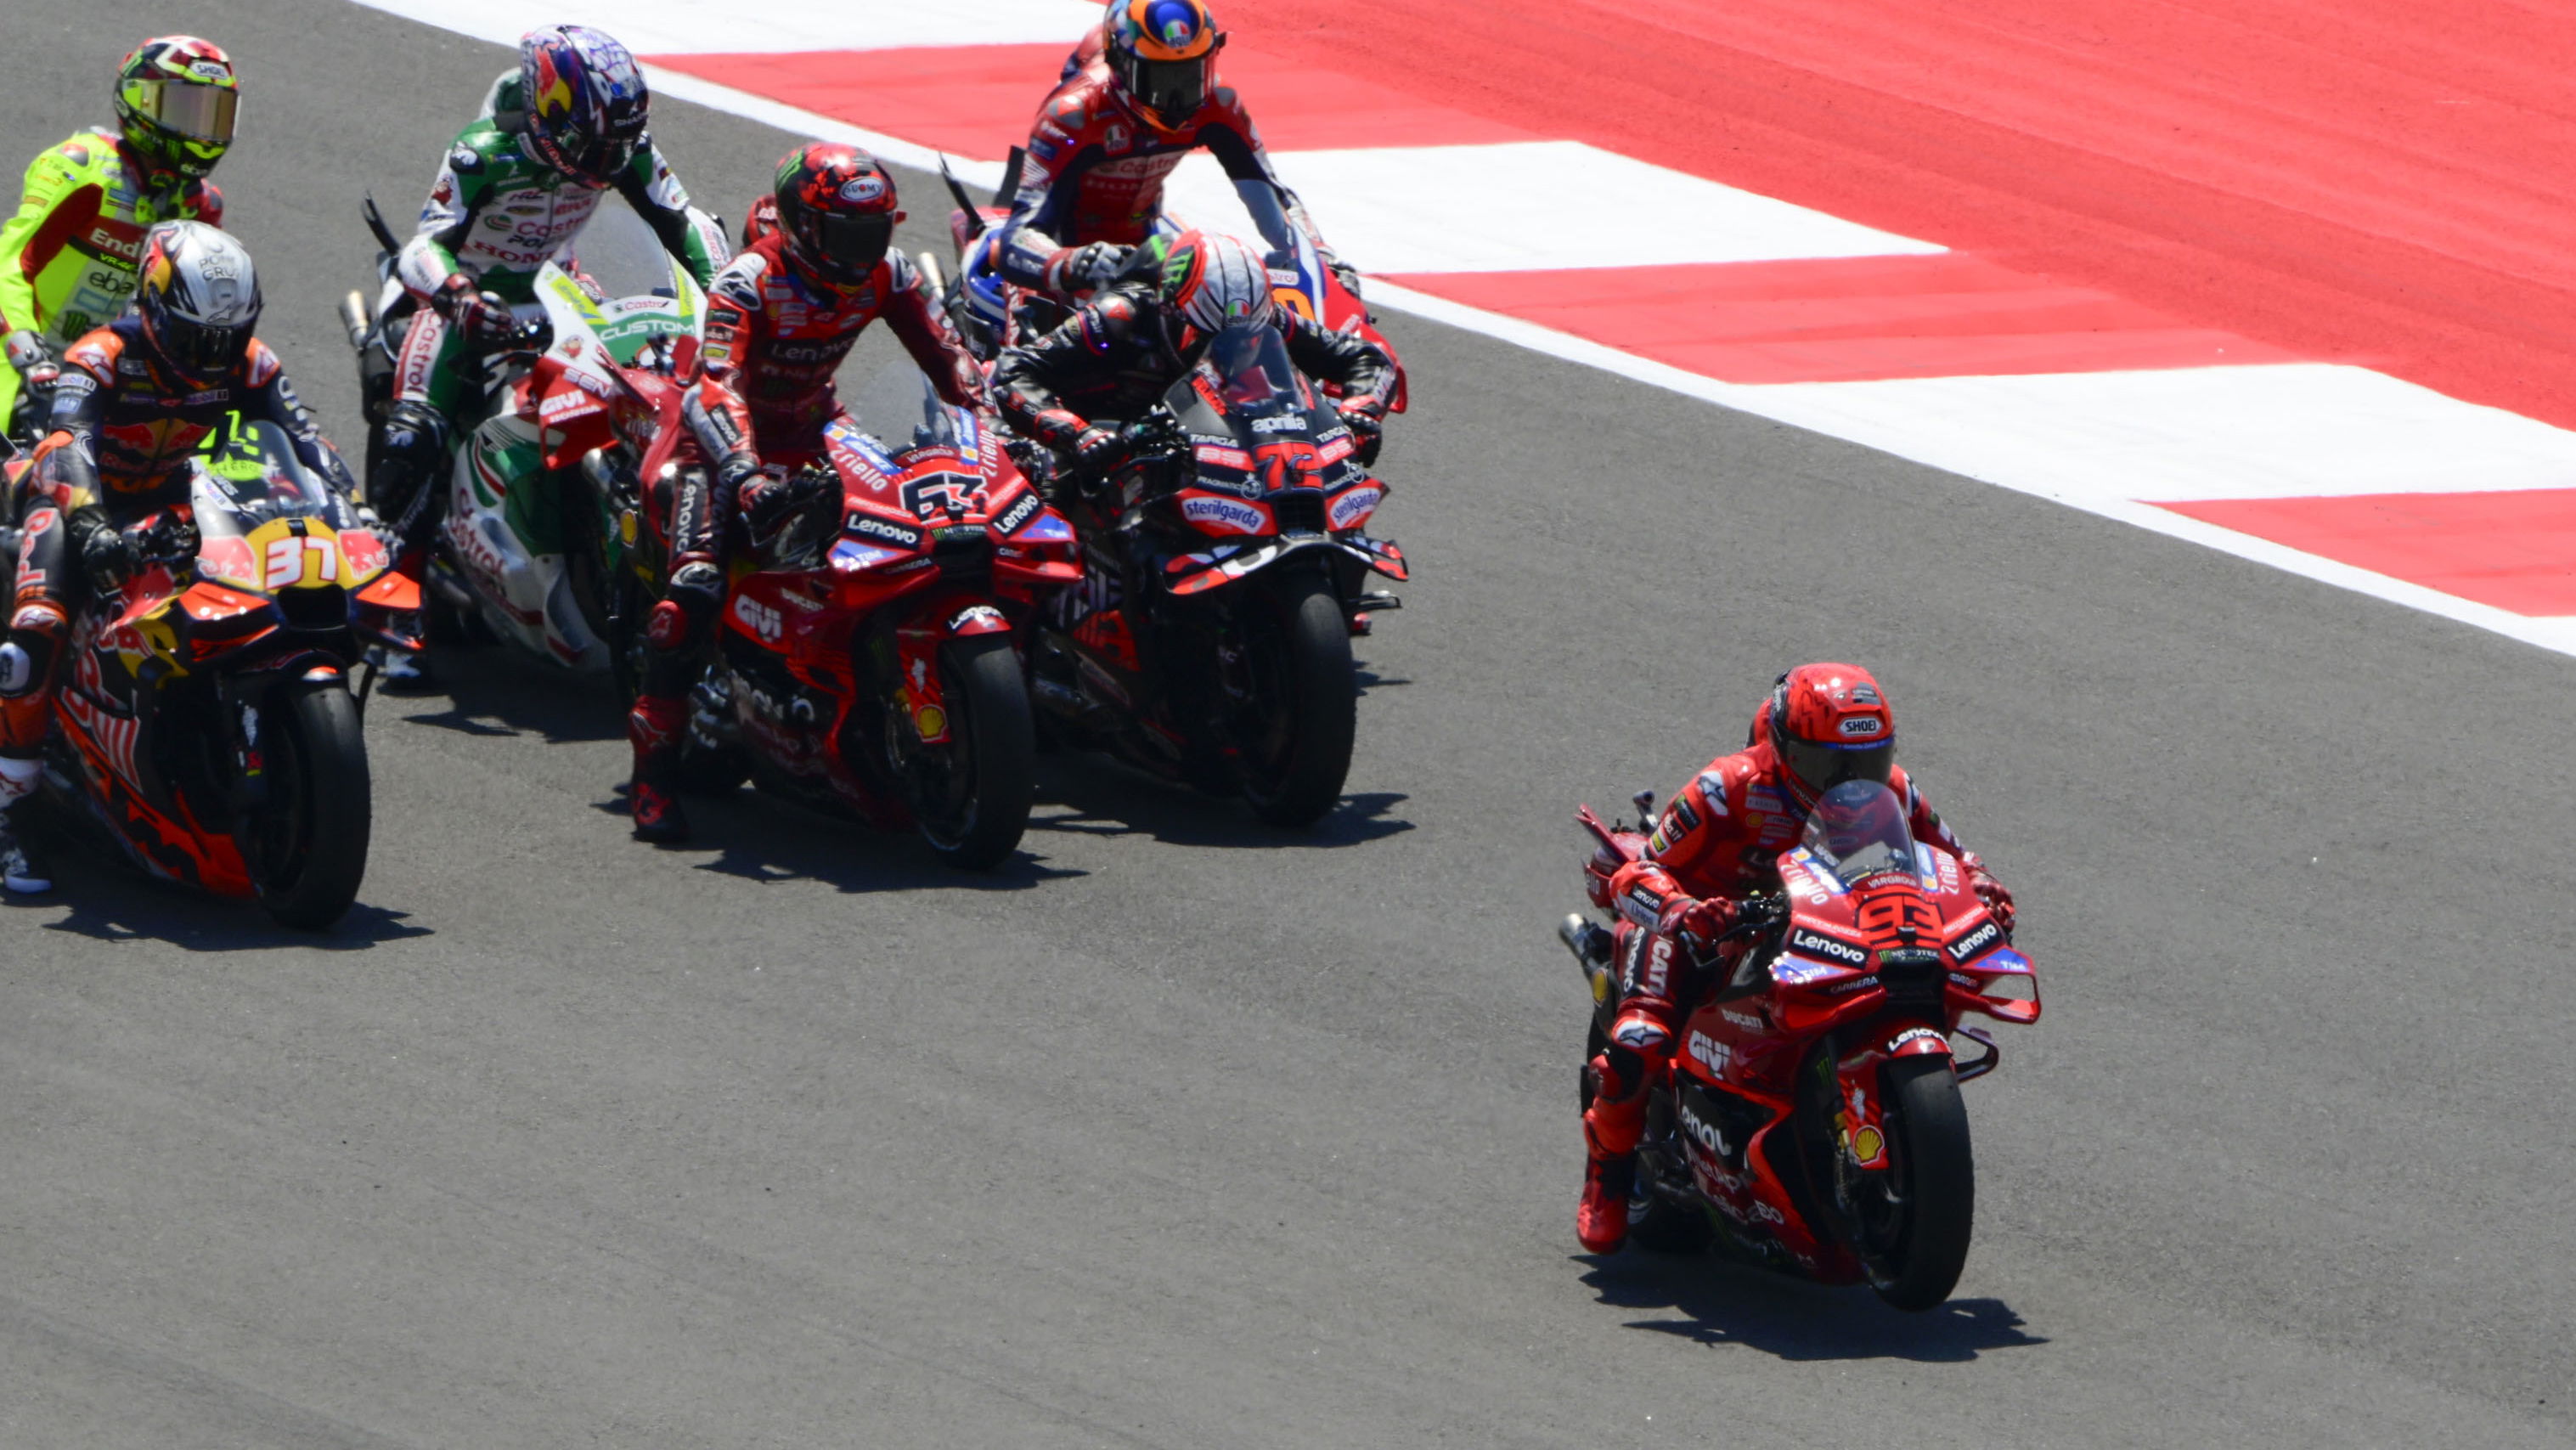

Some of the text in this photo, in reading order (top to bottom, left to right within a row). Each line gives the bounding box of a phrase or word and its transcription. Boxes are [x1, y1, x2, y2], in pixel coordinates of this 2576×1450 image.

[516, 215, 590, 238] Castr
[89, 227, 140, 257] End
[473, 240, 555, 263] HON
[89, 270, 136, 295] eba
[600, 319, 695, 341] CUSTOM
[539, 390, 586, 415] GIVI
[1251, 414, 1308, 433] aprilia
[1190, 434, 1239, 448] TARGA
[676, 472, 706, 552] Lenovo
[993, 494, 1039, 533] Lenovo
[1186, 499, 1260, 529] sterilgarda
[1333, 490, 1379, 521] sterilgarda
[848, 514, 917, 544] Lenovo
[265, 535, 338, 590] 37
[735, 594, 782, 638] GIVI
[1846, 719, 1877, 733] SHOEI
[1855, 892, 1944, 945] 93
[1794, 929, 1865, 962] Lenovo
[1948, 923, 1998, 959] Lenovo
[1623, 926, 1645, 992] enovo
[1649, 935, 1674, 996] CATI
[1830, 976, 1879, 994] CARRERA
[1722, 1008, 1763, 1029] DUCATI
[1688, 1030, 1731, 1071] GIVI
